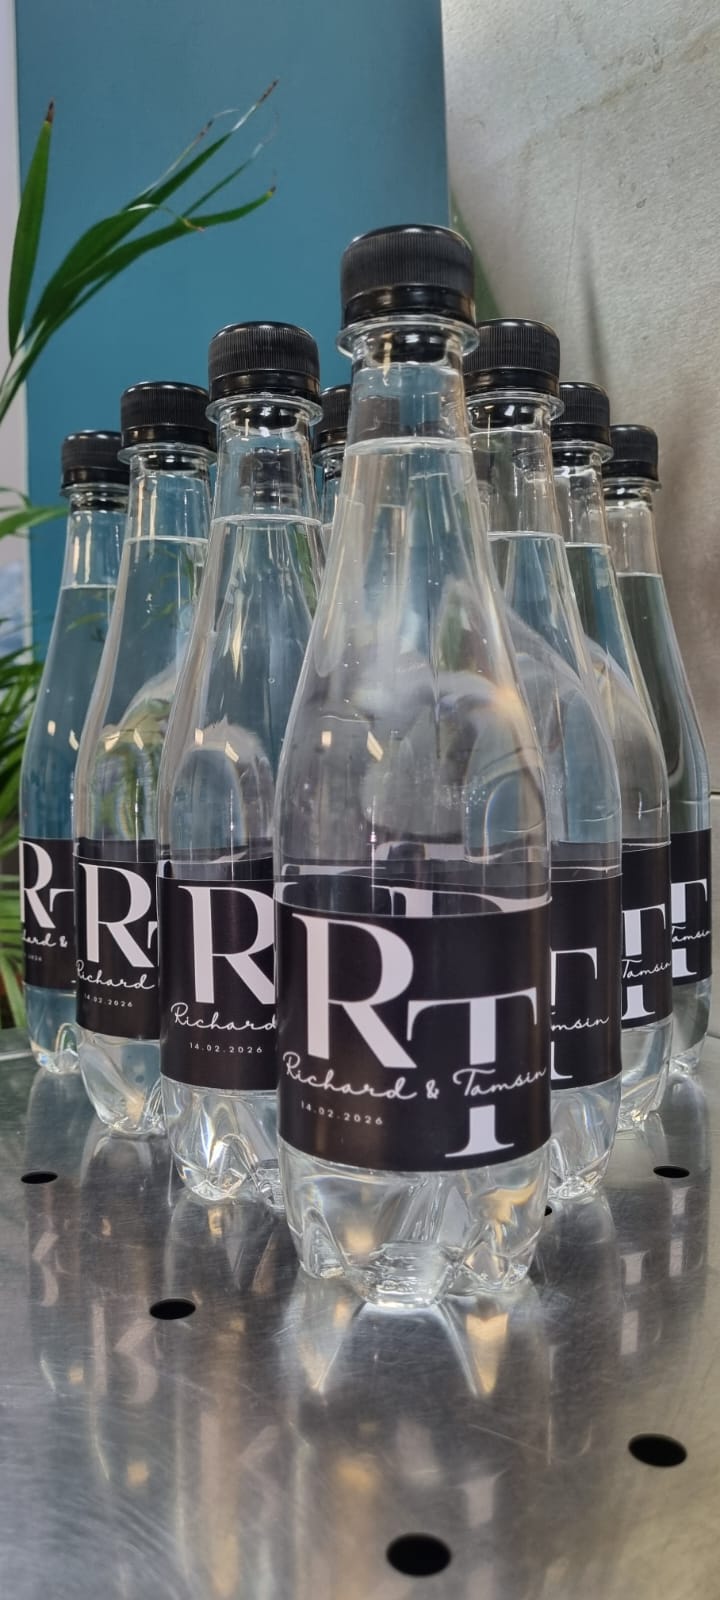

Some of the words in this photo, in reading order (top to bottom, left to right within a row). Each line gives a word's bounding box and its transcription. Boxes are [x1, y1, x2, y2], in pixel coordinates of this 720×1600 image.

[76, 959, 155, 990] Richard
[621, 958, 672, 979] Tamsin
[84, 993, 133, 1008] 14.02.2026
[170, 1002, 277, 1031] Richard
[189, 1042, 263, 1054] 14.02.2026
[283, 1051, 418, 1101] Richard
[426, 1079, 440, 1100] &
[453, 1066, 548, 1098] Tamsin
[300, 1100, 384, 1126] 14.02.2026
